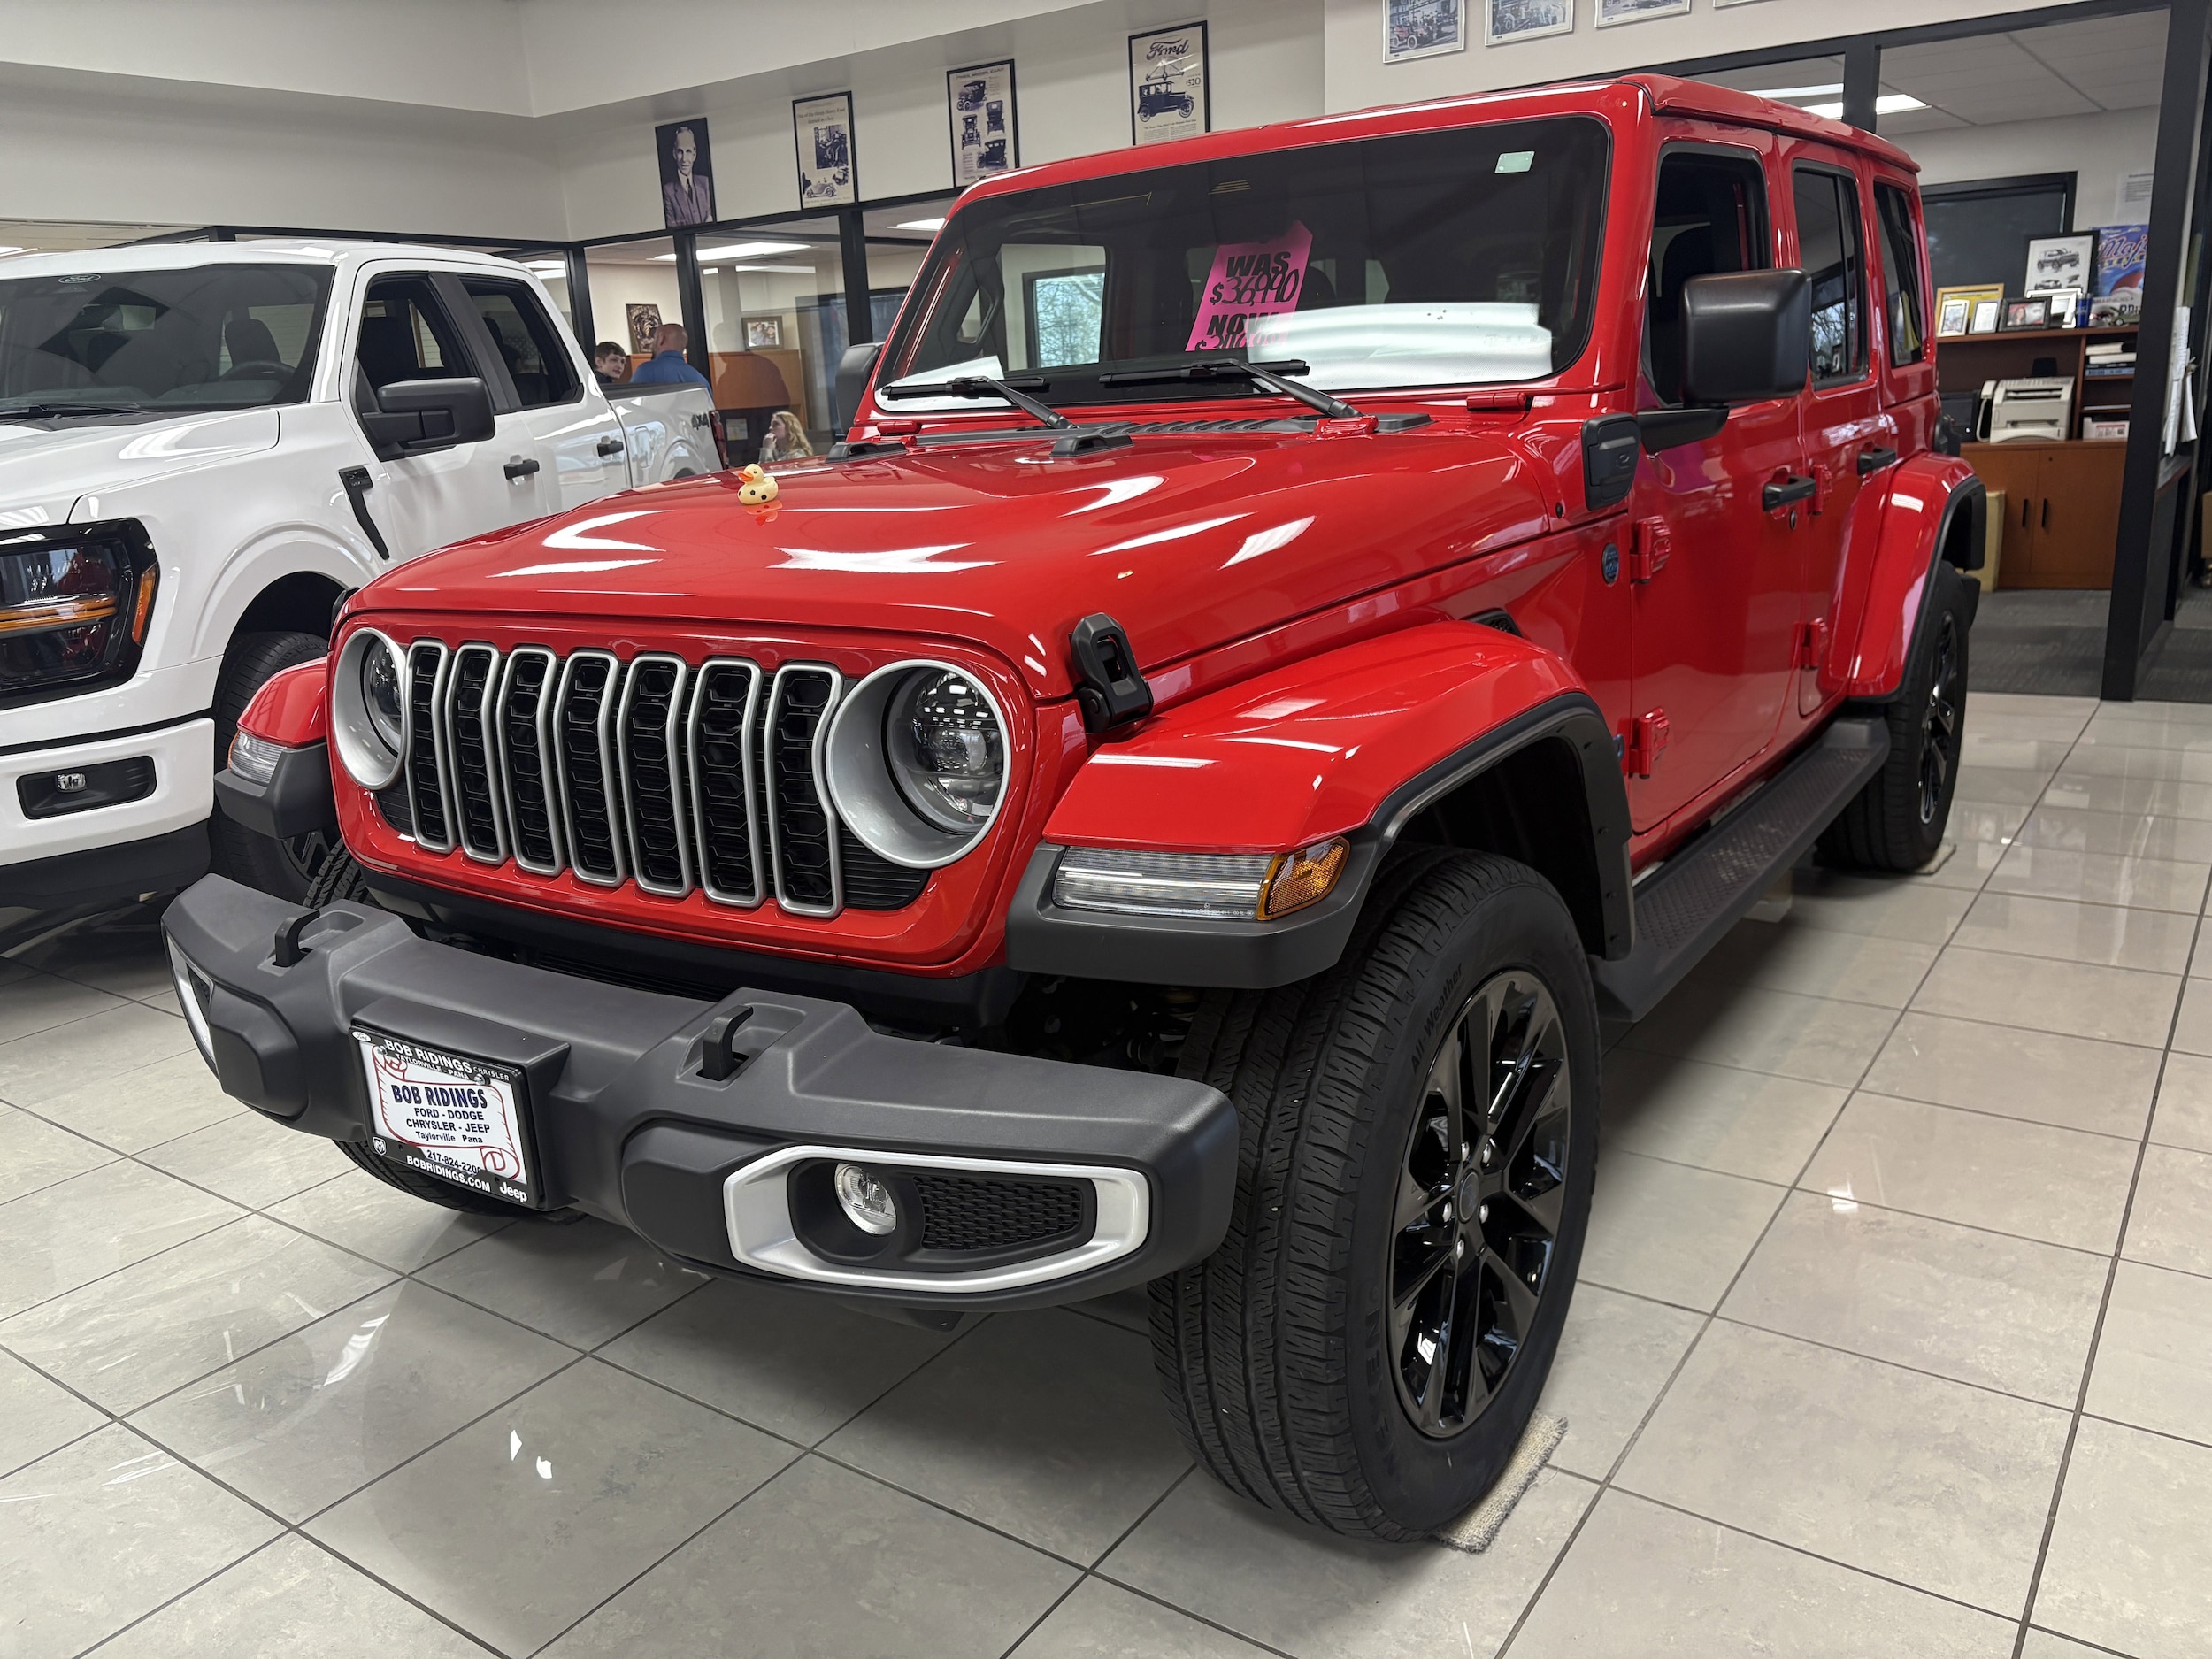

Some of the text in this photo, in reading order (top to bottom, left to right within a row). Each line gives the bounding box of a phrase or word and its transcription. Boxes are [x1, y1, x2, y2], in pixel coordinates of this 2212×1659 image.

[1146, 38, 1190, 60] Ford
[2099, 234, 2147, 270] Maj
[1225, 251, 1291, 277] WAS
[384, 1039, 472, 1073] BOB RIDINGS
[395, 1053, 442, 1072] TAYLORVILLE
[448, 1069, 470, 1080] PANA
[472, 1066, 510, 1081] CHRYSLER
[391, 1085, 488, 1109] BOB RIDINGS
[406, 1118, 457, 1132] CHRYSLER
[465, 1123, 490, 1133] JEEP
[414, 1108, 440, 1118] FORD
[447, 1110, 485, 1120] DODGE
[415, 1131, 483, 1143] Taylorville Pana
[406, 1155, 491, 1193] BOBRIDINGS.COM
[499, 1181, 528, 1203] Jeep
